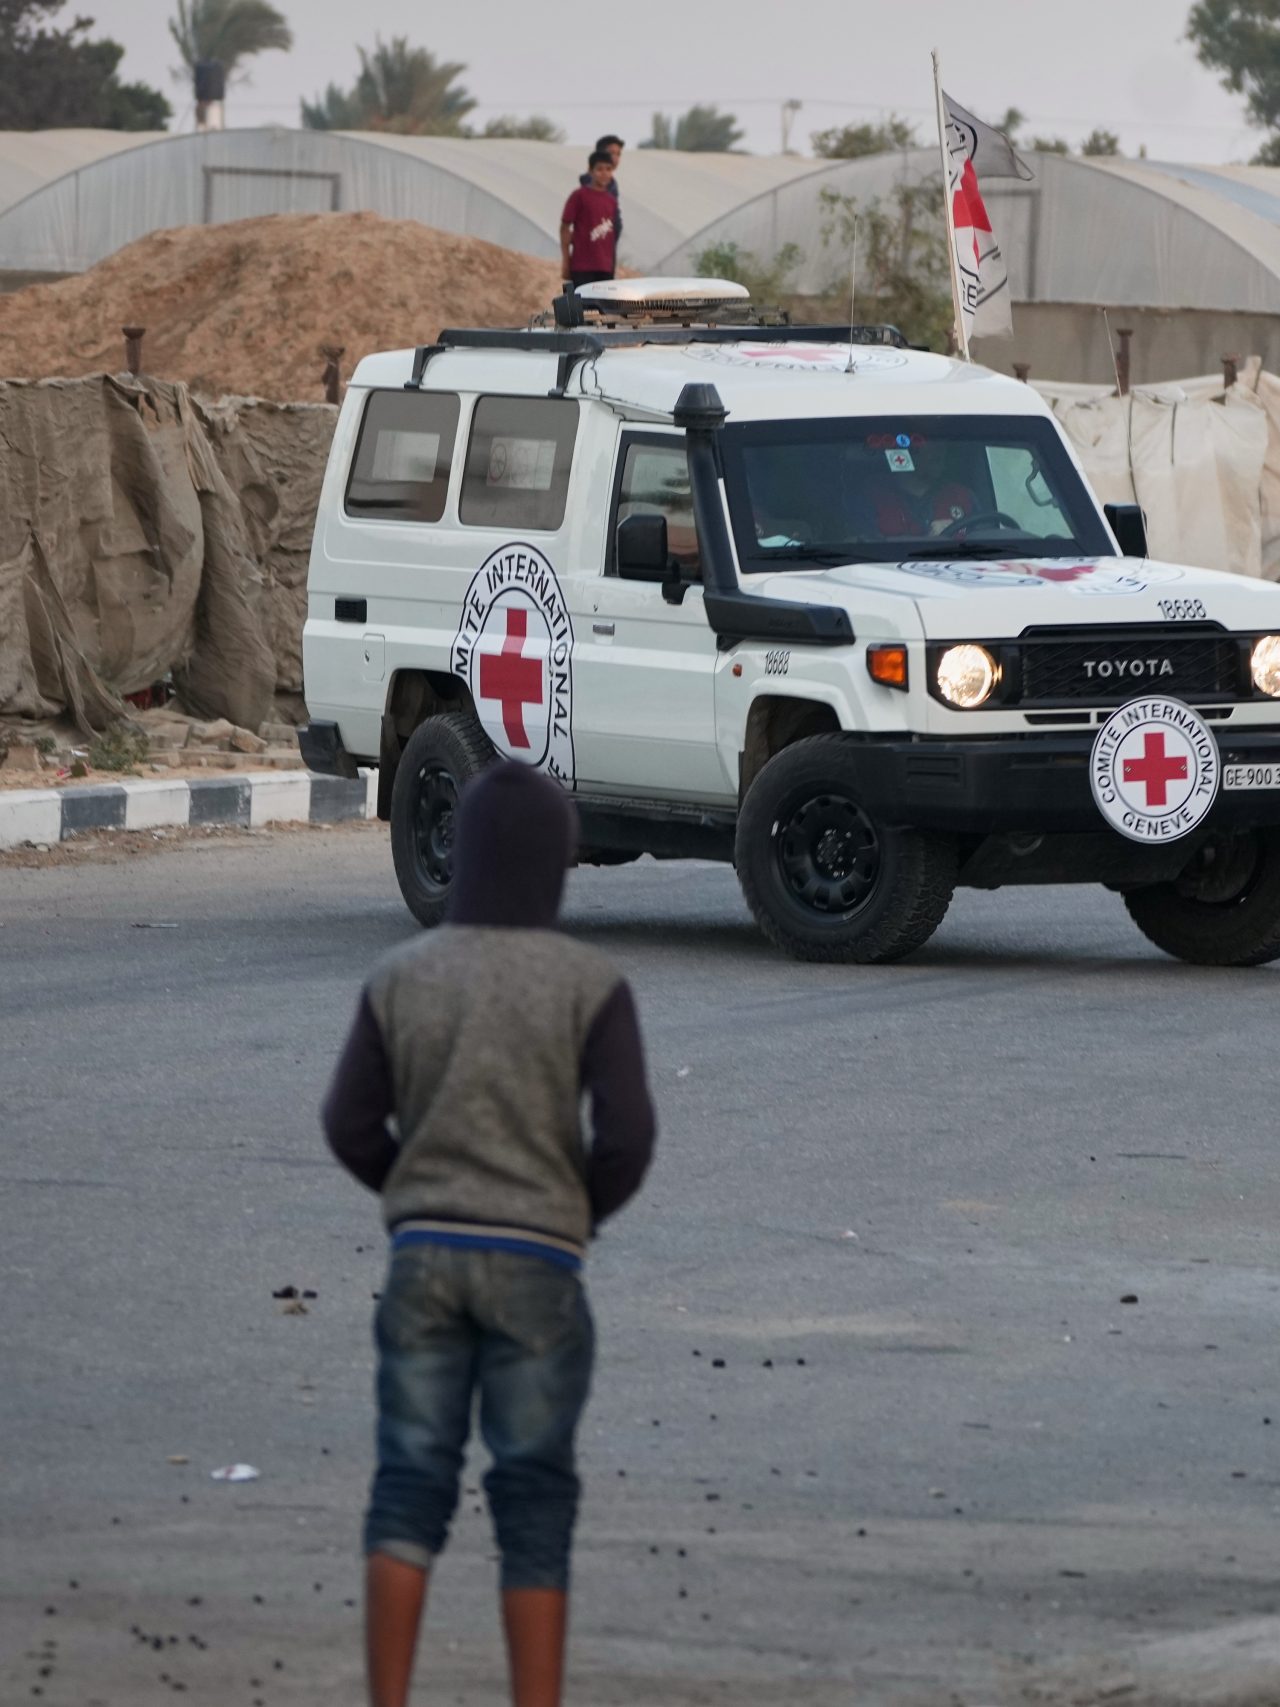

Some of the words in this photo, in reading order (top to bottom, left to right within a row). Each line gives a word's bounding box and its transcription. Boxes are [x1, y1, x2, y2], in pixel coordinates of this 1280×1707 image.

[1157, 599, 1207, 620] 18688
[486, 554, 568, 738] INTERNATIONAL
[1083, 659, 1174, 678] TOYOTA
[1097, 726, 1122, 804] COMITE
[1121, 703, 1214, 798] INTERNATIONAL
[1122, 807, 1195, 836] GENEVE
